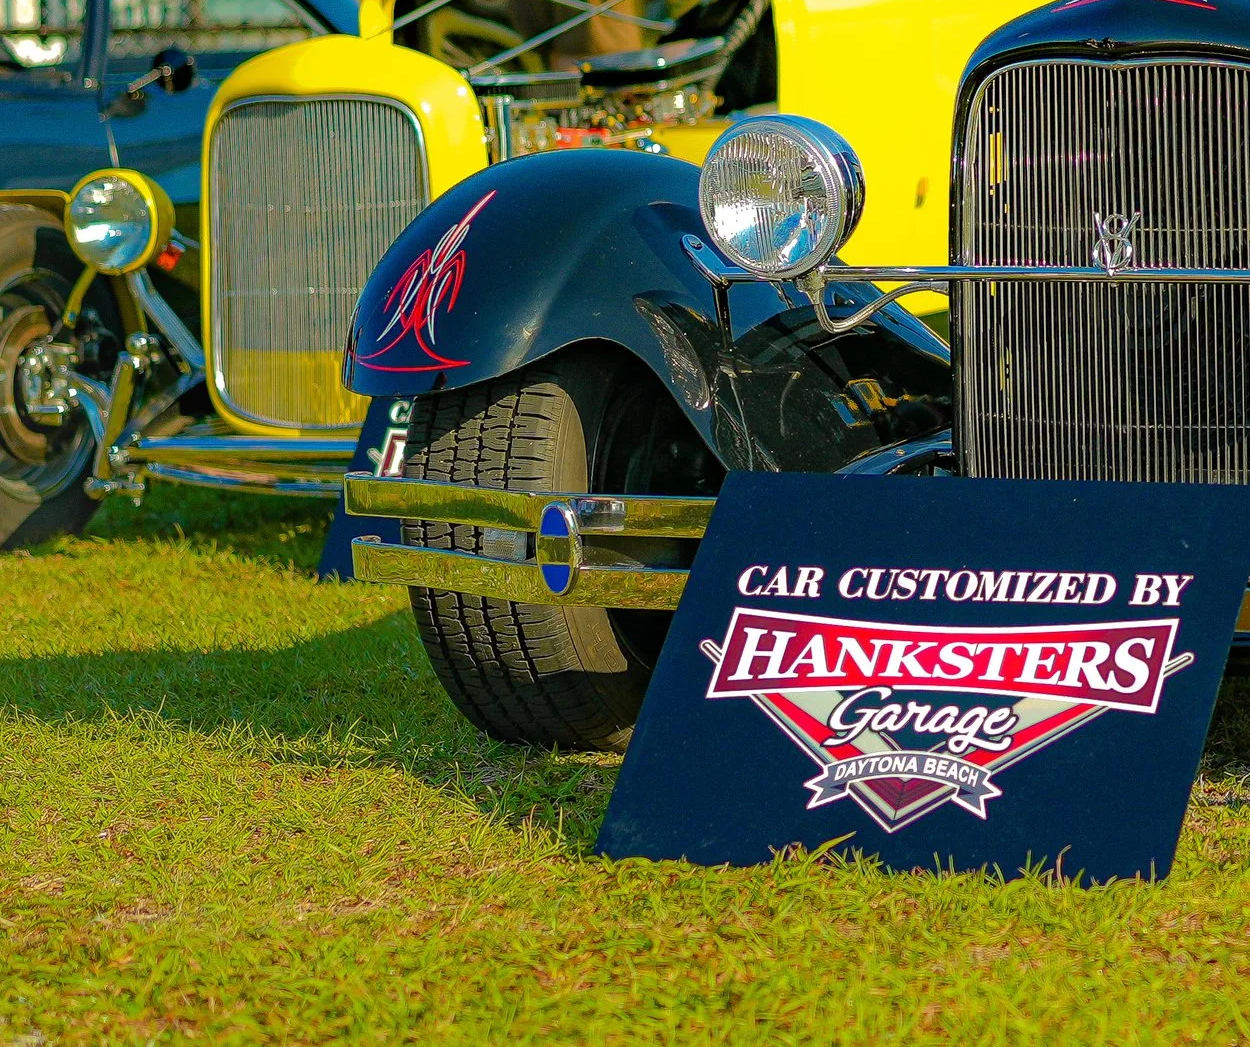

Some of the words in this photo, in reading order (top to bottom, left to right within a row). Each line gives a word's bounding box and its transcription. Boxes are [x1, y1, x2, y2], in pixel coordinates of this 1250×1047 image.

[737, 565, 825, 597] CAR
[837, 567, 1117, 605] CUSTOMIZED
[1128, 574, 1194, 606] BY
[727, 627, 1156, 694] HANKSTERS
[820, 686, 1018, 753] Garage
[834, 756, 920, 781] DAYTONA
[922, 758, 979, 787] BEACH
